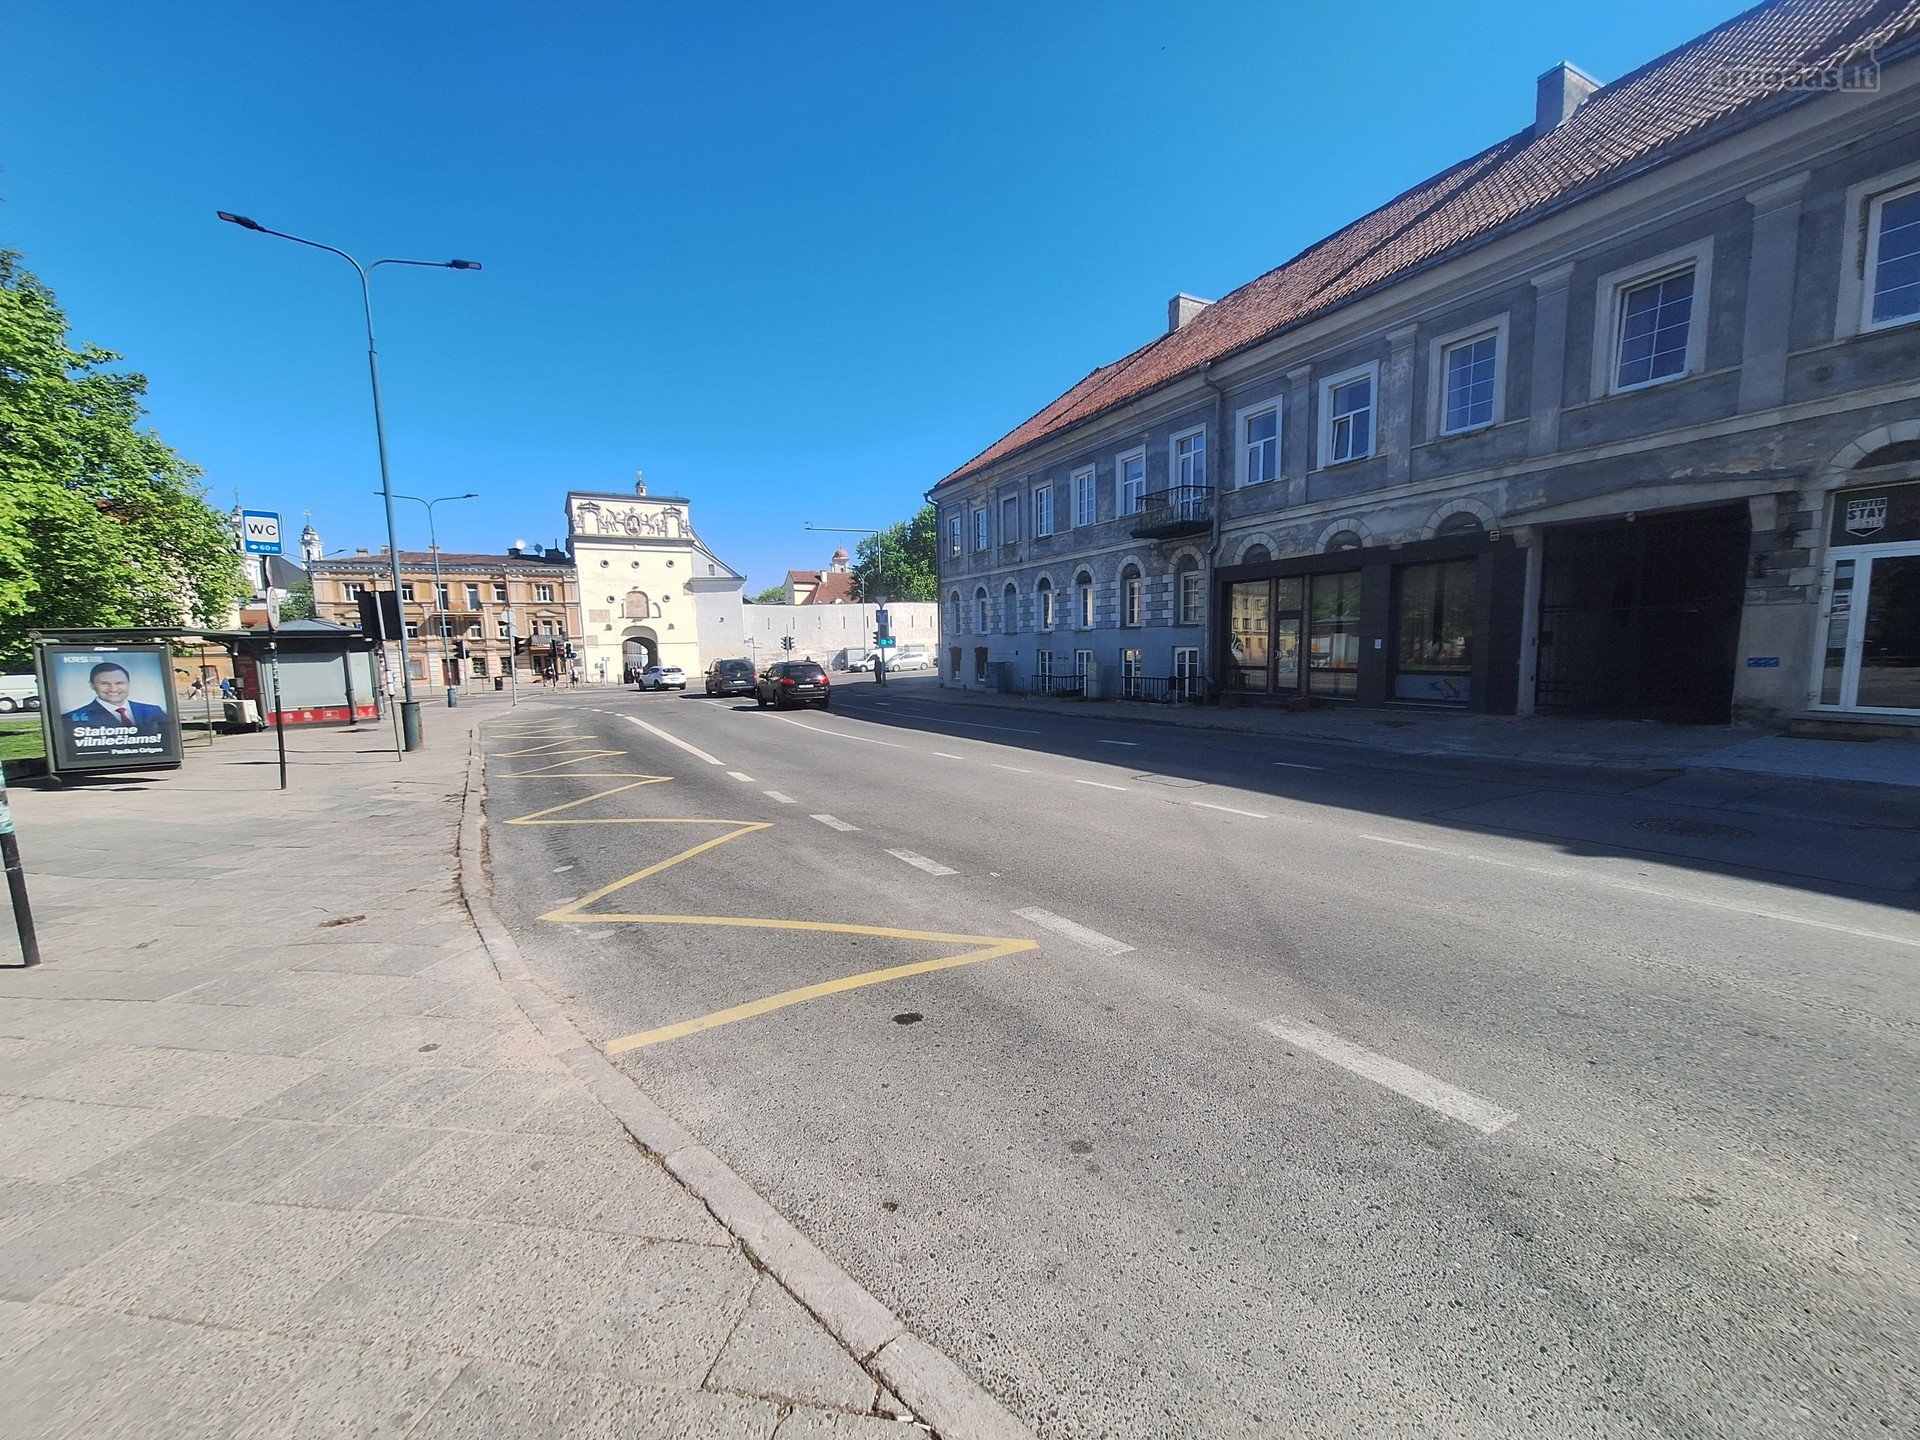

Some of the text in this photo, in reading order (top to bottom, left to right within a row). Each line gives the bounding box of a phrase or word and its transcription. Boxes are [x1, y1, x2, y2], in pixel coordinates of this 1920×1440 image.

[1849, 499, 1886, 510] CENTER
[1848, 507, 1885, 520] STAY
[248, 523, 276, 536] WC
[73, 726, 138, 737] Statome
[74, 733, 162, 747] vilniečiams!
